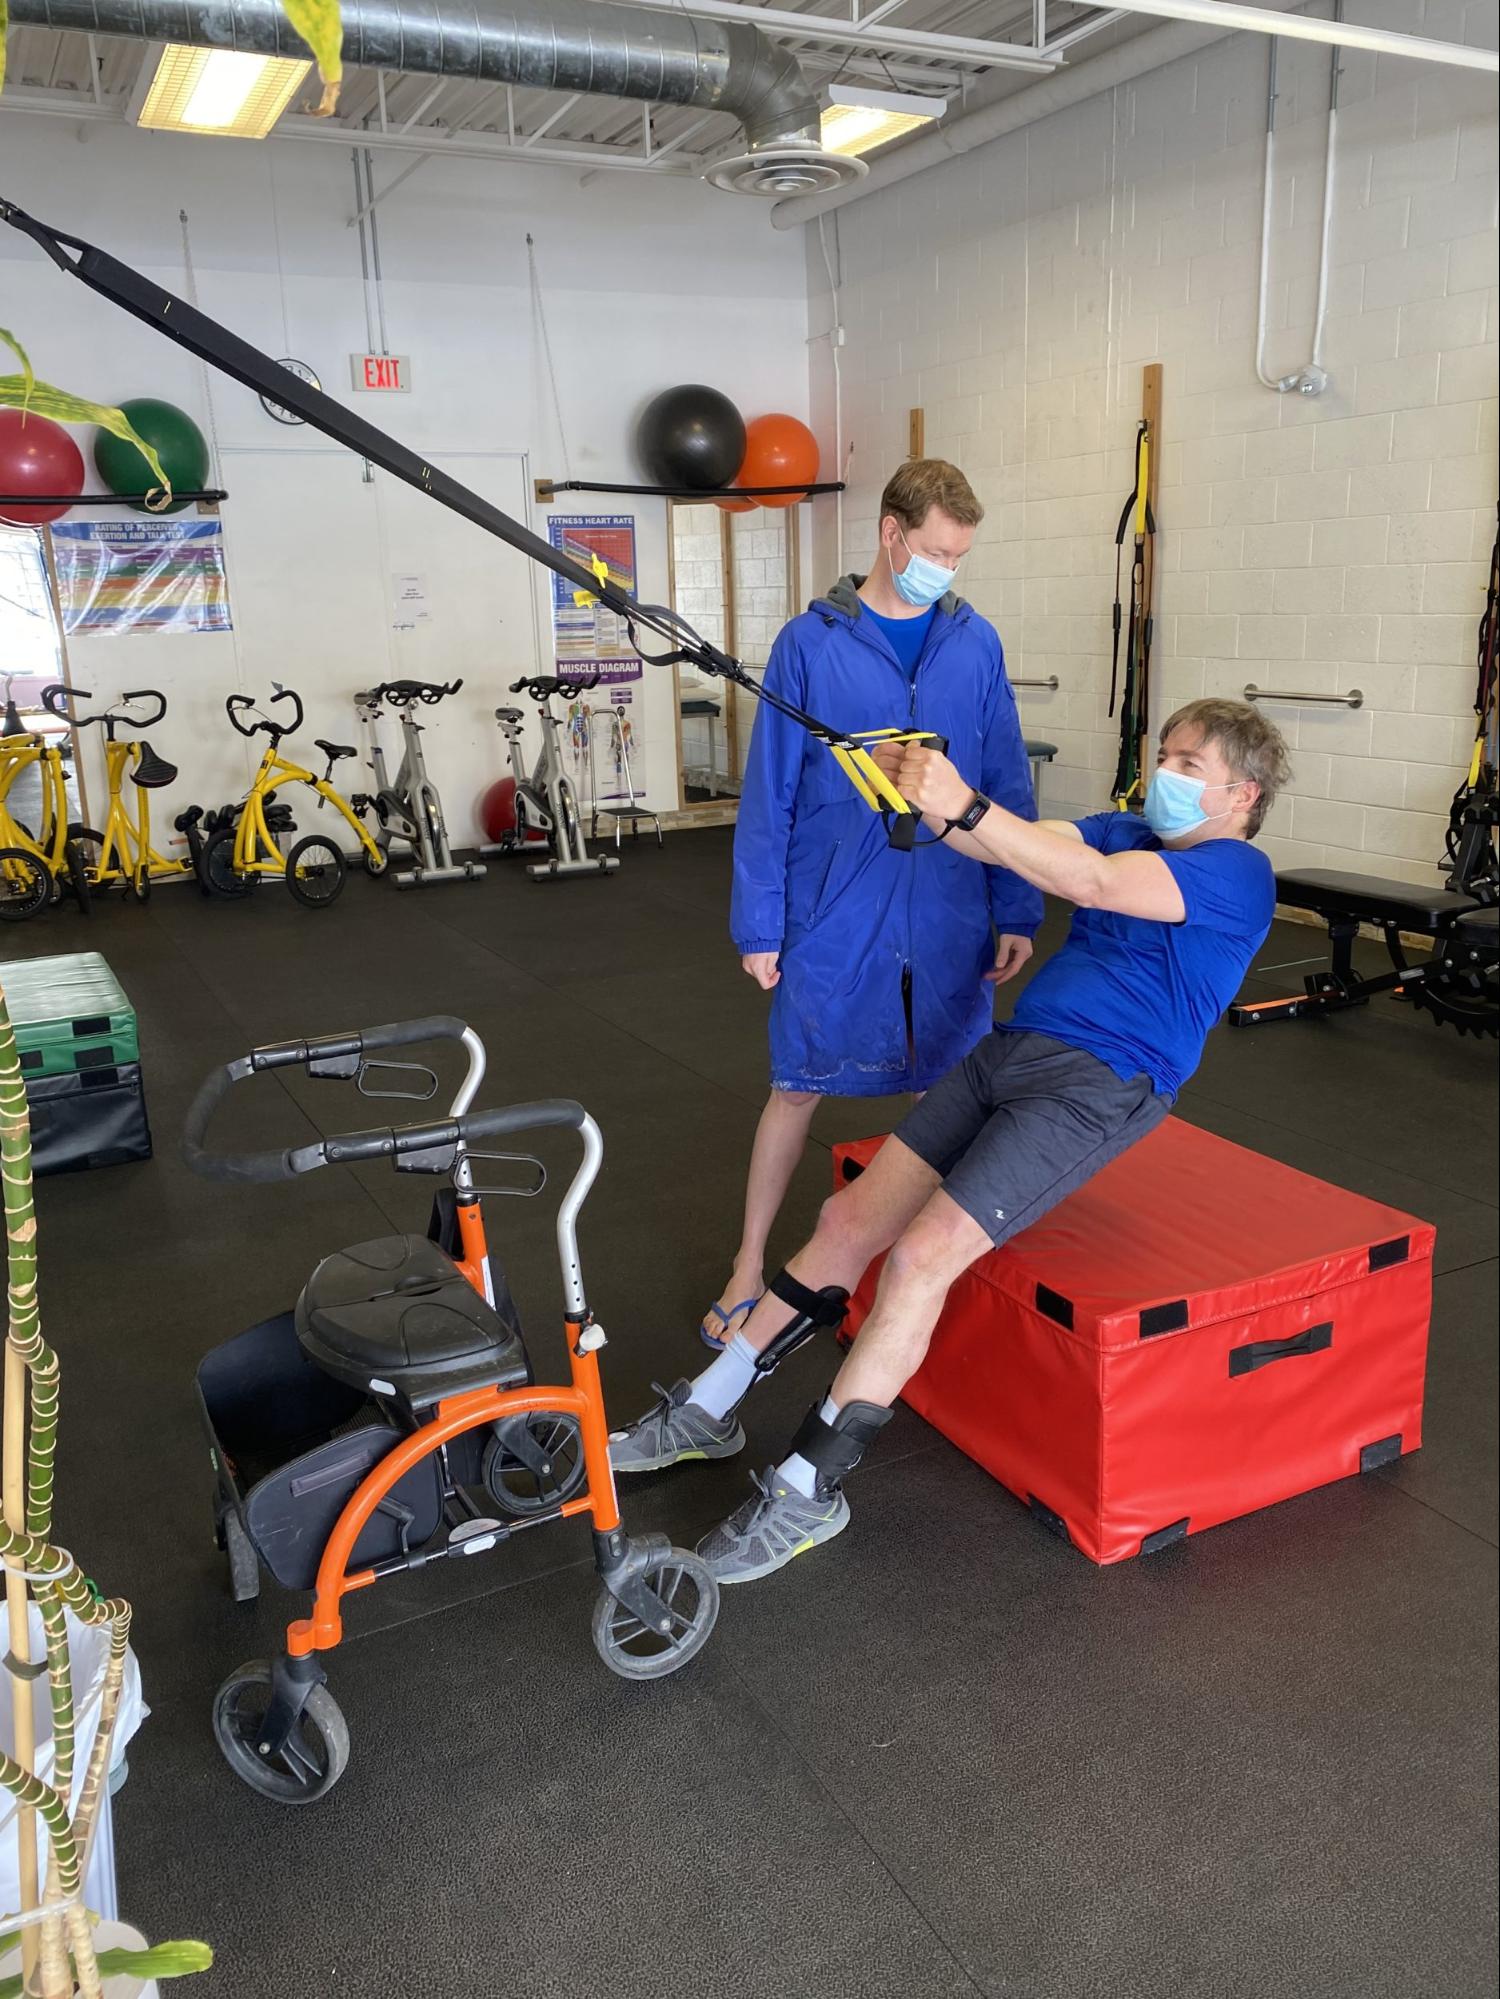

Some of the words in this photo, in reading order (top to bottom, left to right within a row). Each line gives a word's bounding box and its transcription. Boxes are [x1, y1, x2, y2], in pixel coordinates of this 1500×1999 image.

[364, 358, 399, 388] EXIT
[549, 517, 584, 525] FITNESS
[585, 517, 612, 525] HEART
[613, 517, 633, 525] RATE
[94, 523, 123, 531] RATING
[125, 523, 136, 531] OF
[90, 531, 128, 540] EXERTION
[129, 531, 146, 540] AND
[560, 663, 597, 674] MUSCLE
[598, 662, 640, 673] DIAGRAM
